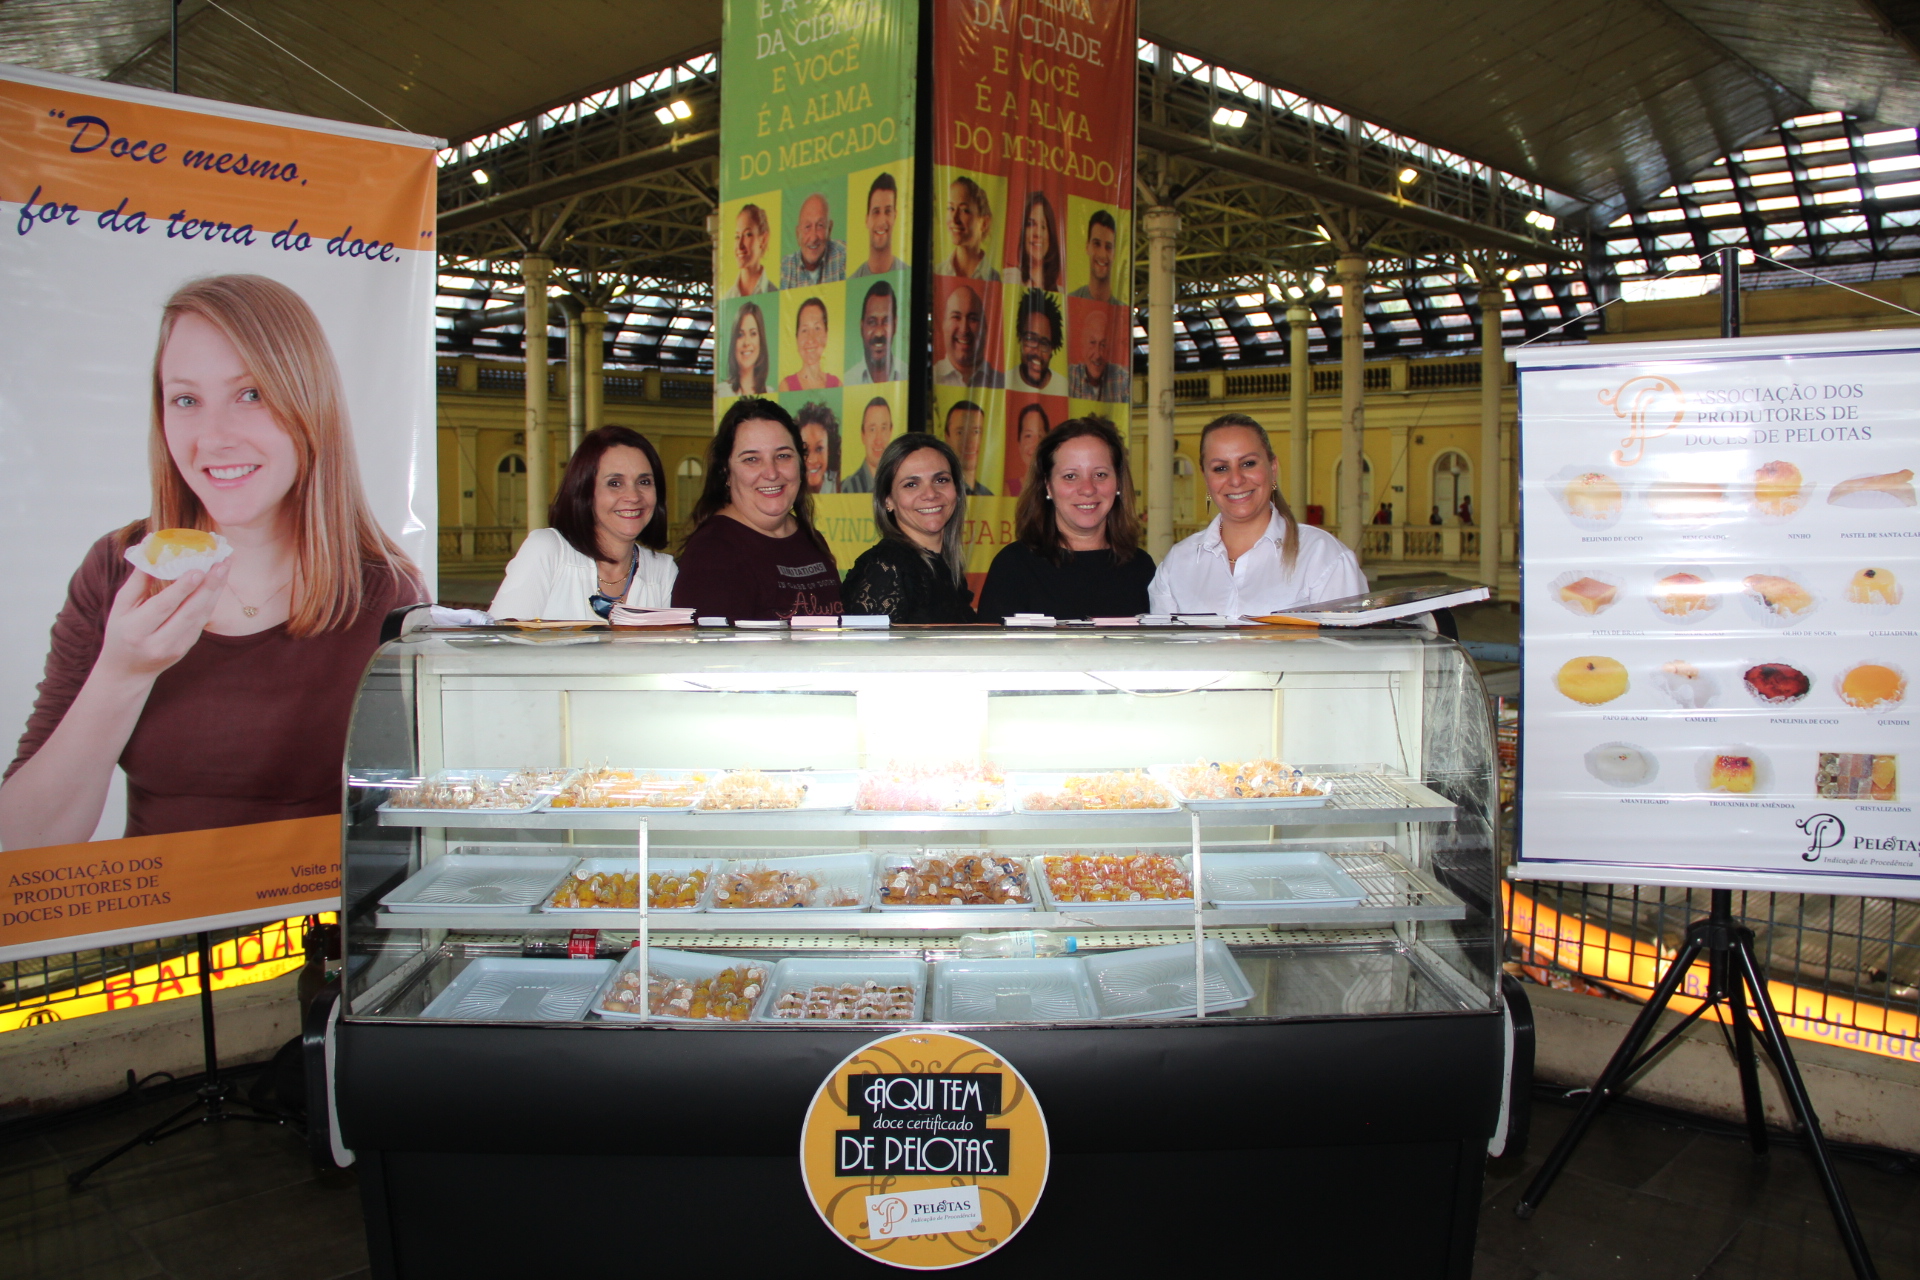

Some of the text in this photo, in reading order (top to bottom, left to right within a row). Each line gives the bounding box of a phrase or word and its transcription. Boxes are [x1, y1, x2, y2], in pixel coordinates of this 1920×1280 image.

[756, 29, 787, 60] DA
[973, 0, 1104, 68] DA CIDADE.
[772, 36, 860, 94] E VOCÊ
[993, 45, 1080, 98] E VOCÊ
[757, 82, 873, 138] É A ALMA
[975, 77, 1093, 143] É A ALMA
[182, 147, 308, 187] mesmo.
[739, 151, 771, 181] DO
[954, 120, 1118, 188] DO MERCADO.
[17, 185, 81, 236] for
[97, 198, 150, 235] da
[166, 209, 257, 246] terra
[272, 219, 313, 251] do
[1694, 382, 1864, 406] ASSOCIAÇÃO DOS
[1698, 405, 1859, 424] PRODUTORES DE
[1685, 425, 1872, 447] DOCES DE PELOTAS
[1709, 800, 1749, 808] TROUXINHA
[1760, 801, 1795, 809] AMÊNDOA
[8, 856, 163, 888] ASSOCIAÇÃO DOS
[291, 863, 327, 878] Visite
[1823, 856, 1914, 867] Indicação de Procedência
[13, 875, 160, 906] PRODUTORES DE
[2, 891, 172, 926] DOCES DE PELOTAS
[864, 1077, 983, 1113] AQUI TEM
[873, 1113, 974, 1135] doce certificado
[841, 1136, 998, 1174] DE PELOTAS.
[910, 1215, 936, 1223] Indicação
[913, 1200, 971, 1215] PELOTAS
